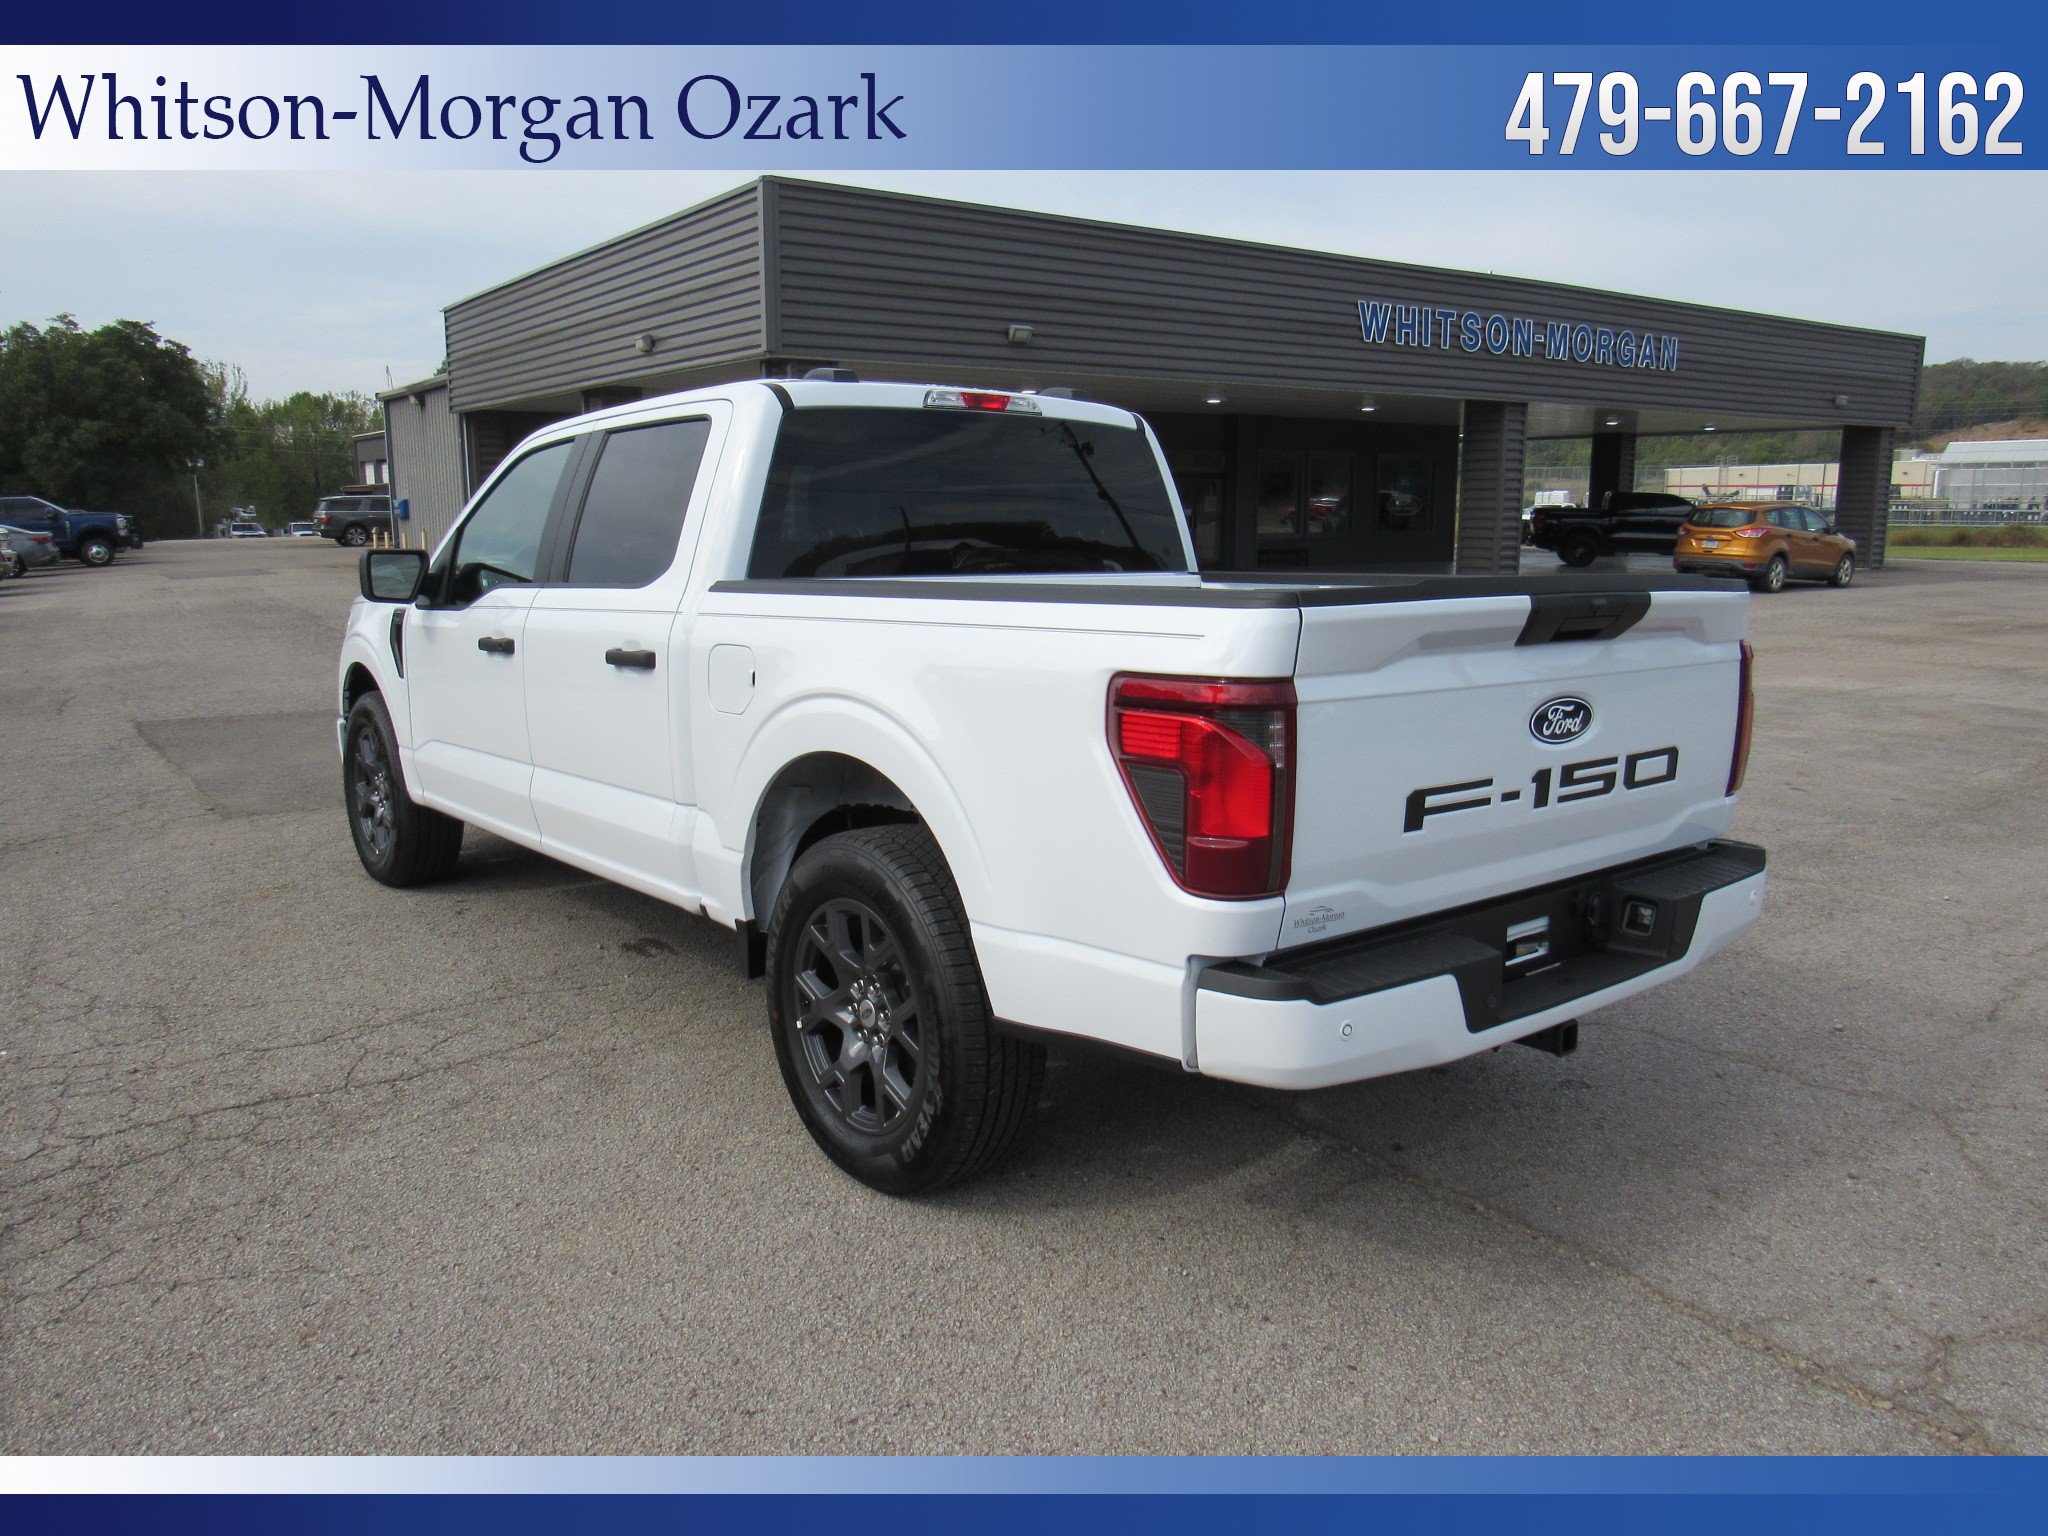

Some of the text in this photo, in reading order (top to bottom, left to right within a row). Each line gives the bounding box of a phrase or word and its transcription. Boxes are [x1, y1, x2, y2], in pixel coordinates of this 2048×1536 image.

[1358, 300, 1679, 371] WHITSON-MORGAN
[1542, 704, 1583, 736] Ford
[1403, 746, 1679, 834] F-150
